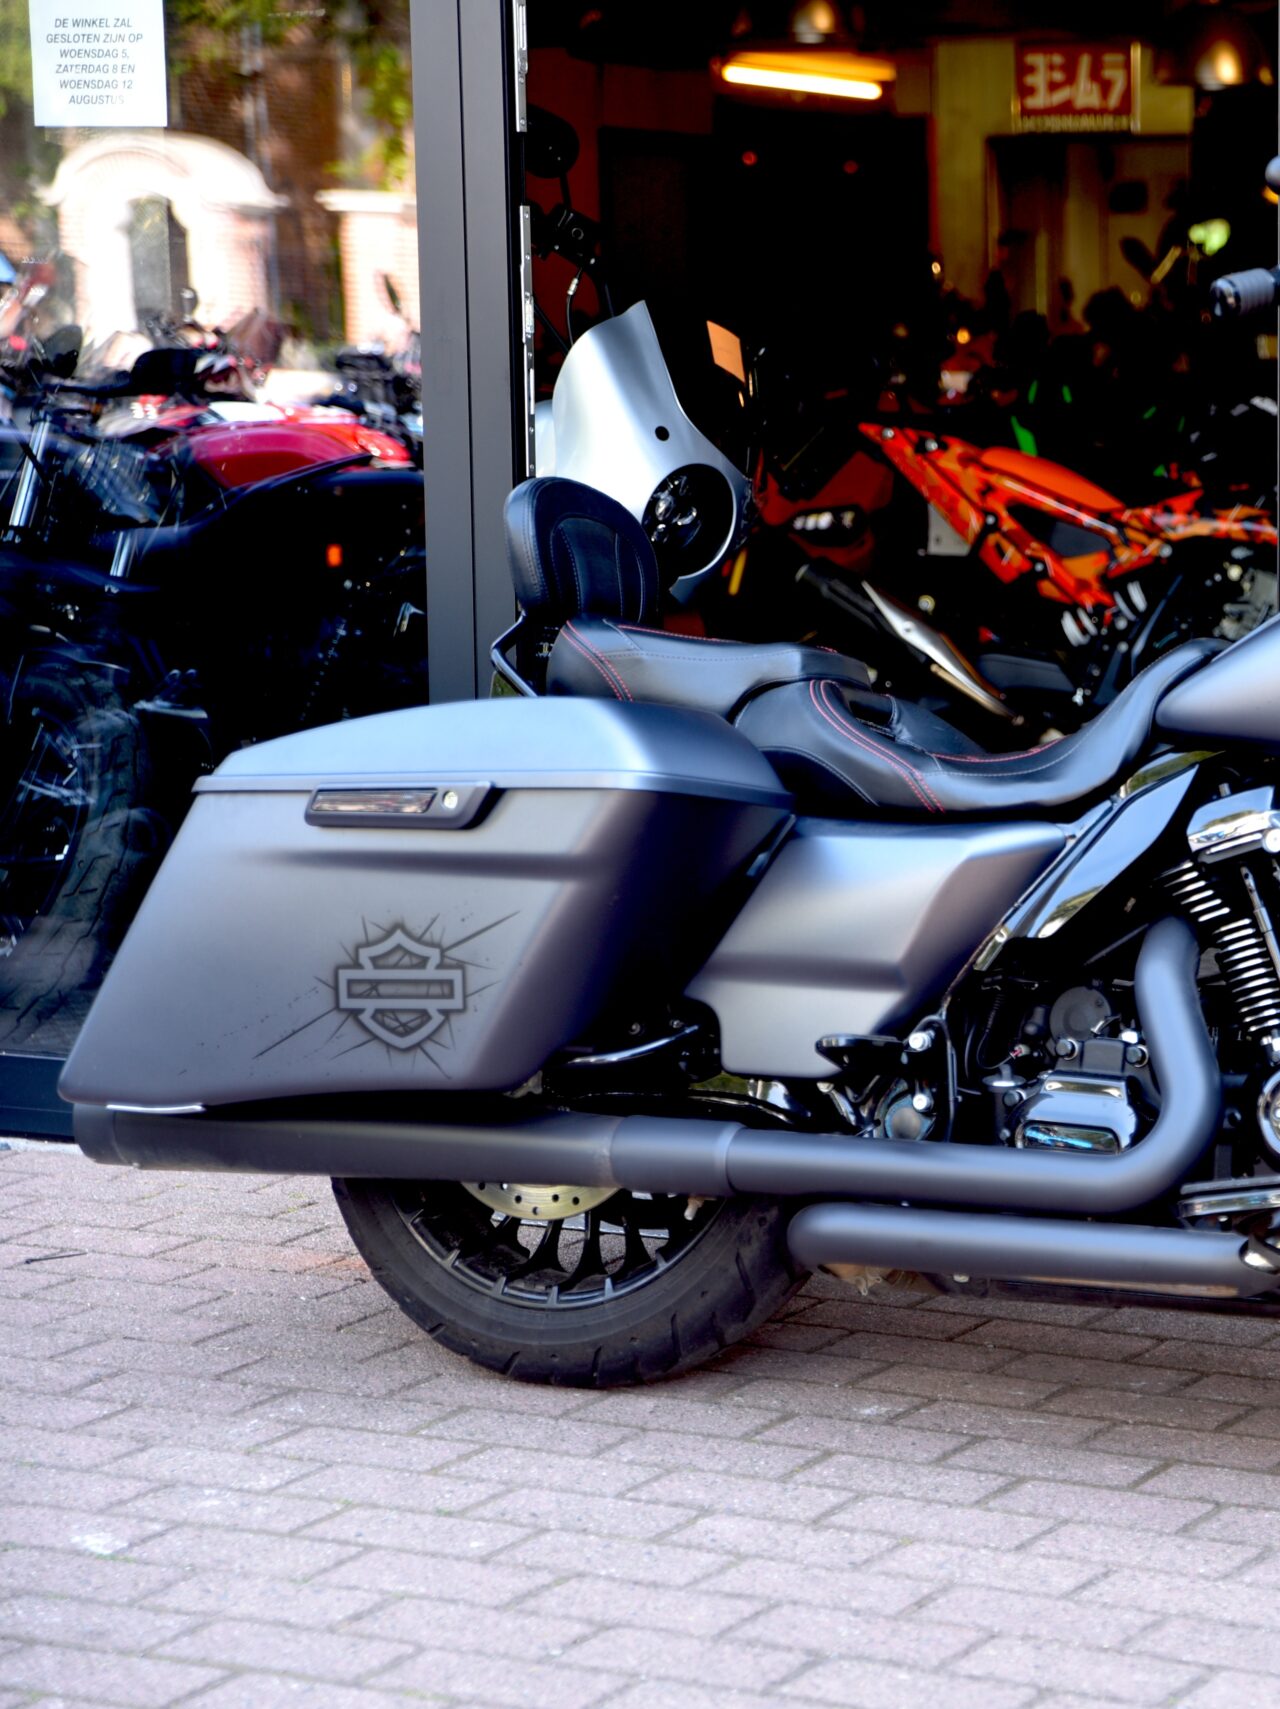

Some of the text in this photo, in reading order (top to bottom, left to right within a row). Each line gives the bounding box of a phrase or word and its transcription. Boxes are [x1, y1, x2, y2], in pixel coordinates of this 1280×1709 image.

[54, 18, 132, 28] DE WINKEL ZAL
[46, 33, 143, 44] GESLOTEN ZIJN OP
[59, 49, 119, 59] WOENSDAG
[55, 64, 135, 74] ZATERDAG 8 EN
[59, 79, 133, 89] WOENSDAG 12
[1023, 53, 1127, 111] ヨシムラ
[68, 95, 124, 105] AUGUSTUS
